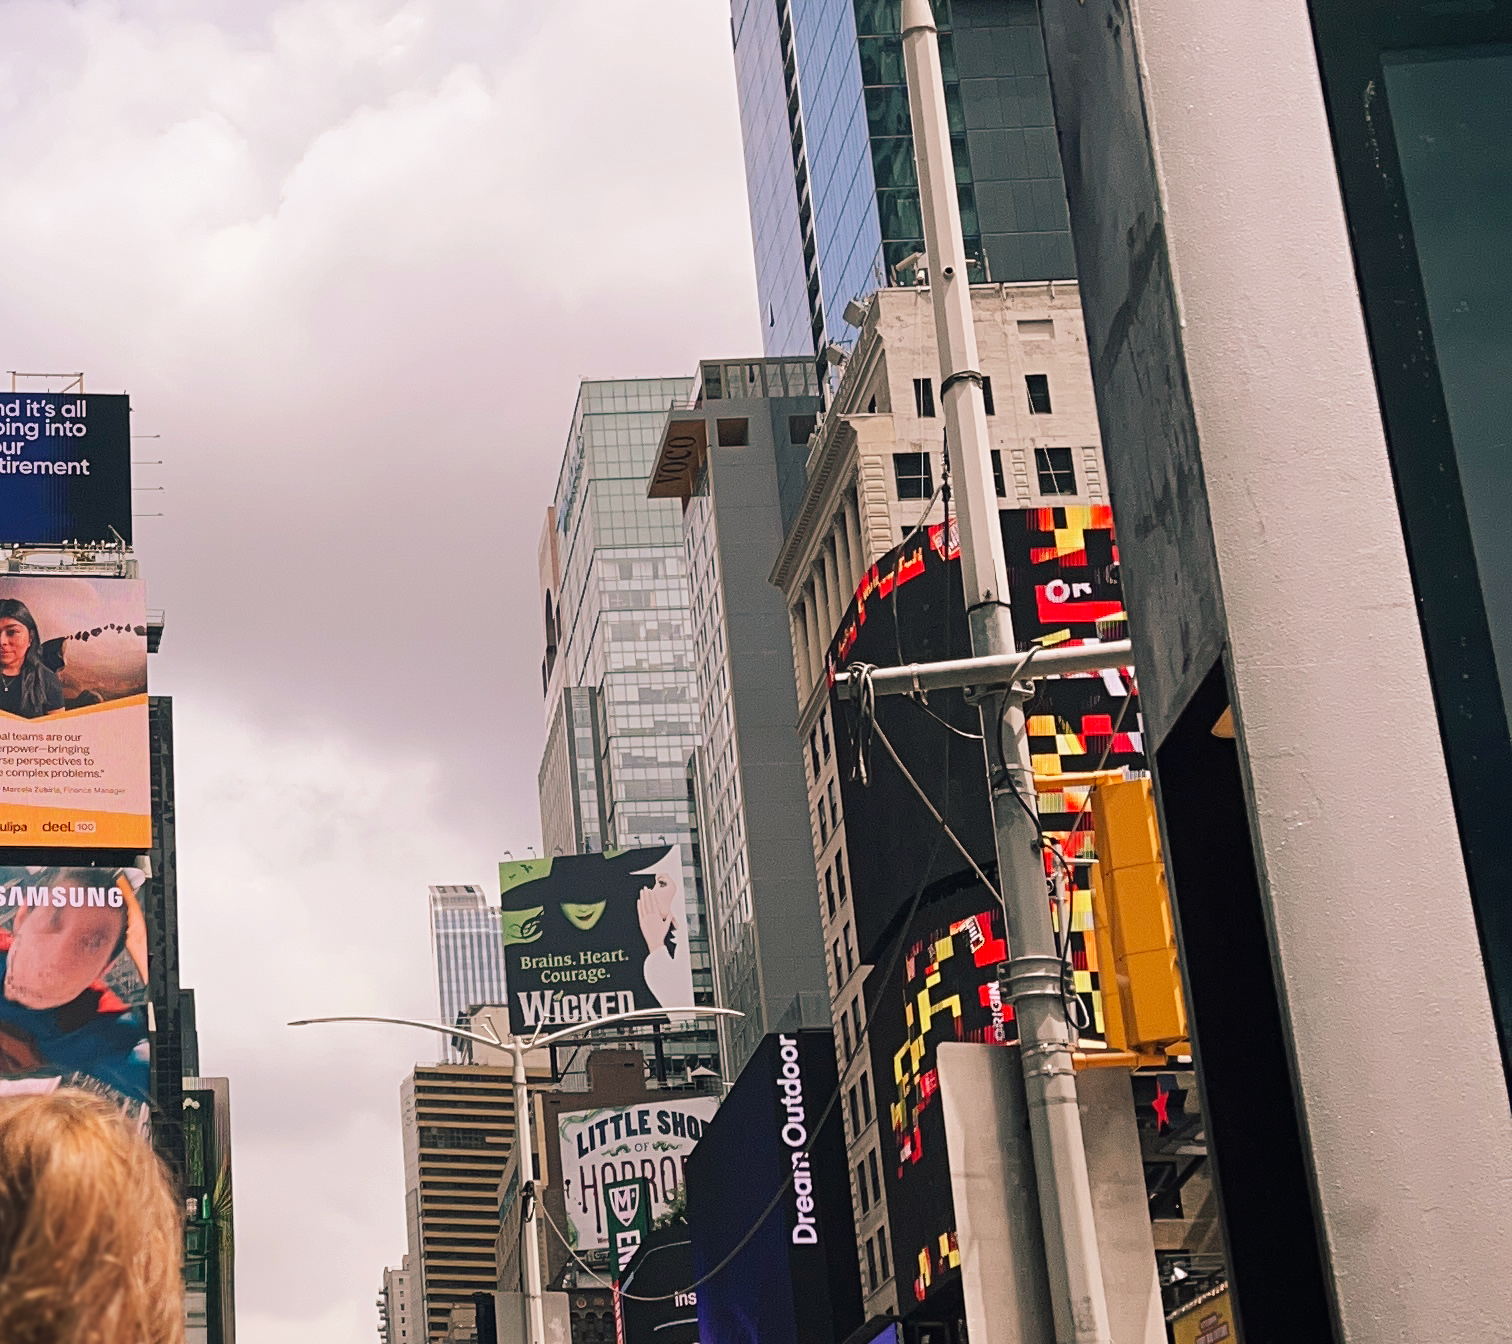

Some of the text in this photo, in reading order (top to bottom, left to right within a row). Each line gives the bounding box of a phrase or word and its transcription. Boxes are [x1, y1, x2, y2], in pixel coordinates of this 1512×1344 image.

[60, 399, 87, 418] all
[44, 418, 87, 437] into
[12, 732, 45, 742] teams
[45, 734, 63, 742] are
[64, 734, 83, 742] our
[16, 756, 82, 767] perspectives
[83, 757, 95, 766] to
[5, 768, 50, 779] complex
[76, 823, 94, 832] 100
[519, 949, 630, 970] Brains. Heart.
[540, 967, 611, 984] Courage.
[576, 1109, 652, 1159] LITTLE
[776, 1032, 819, 1245] Dream Outdoor
[634, 1141, 649, 1153] OF
